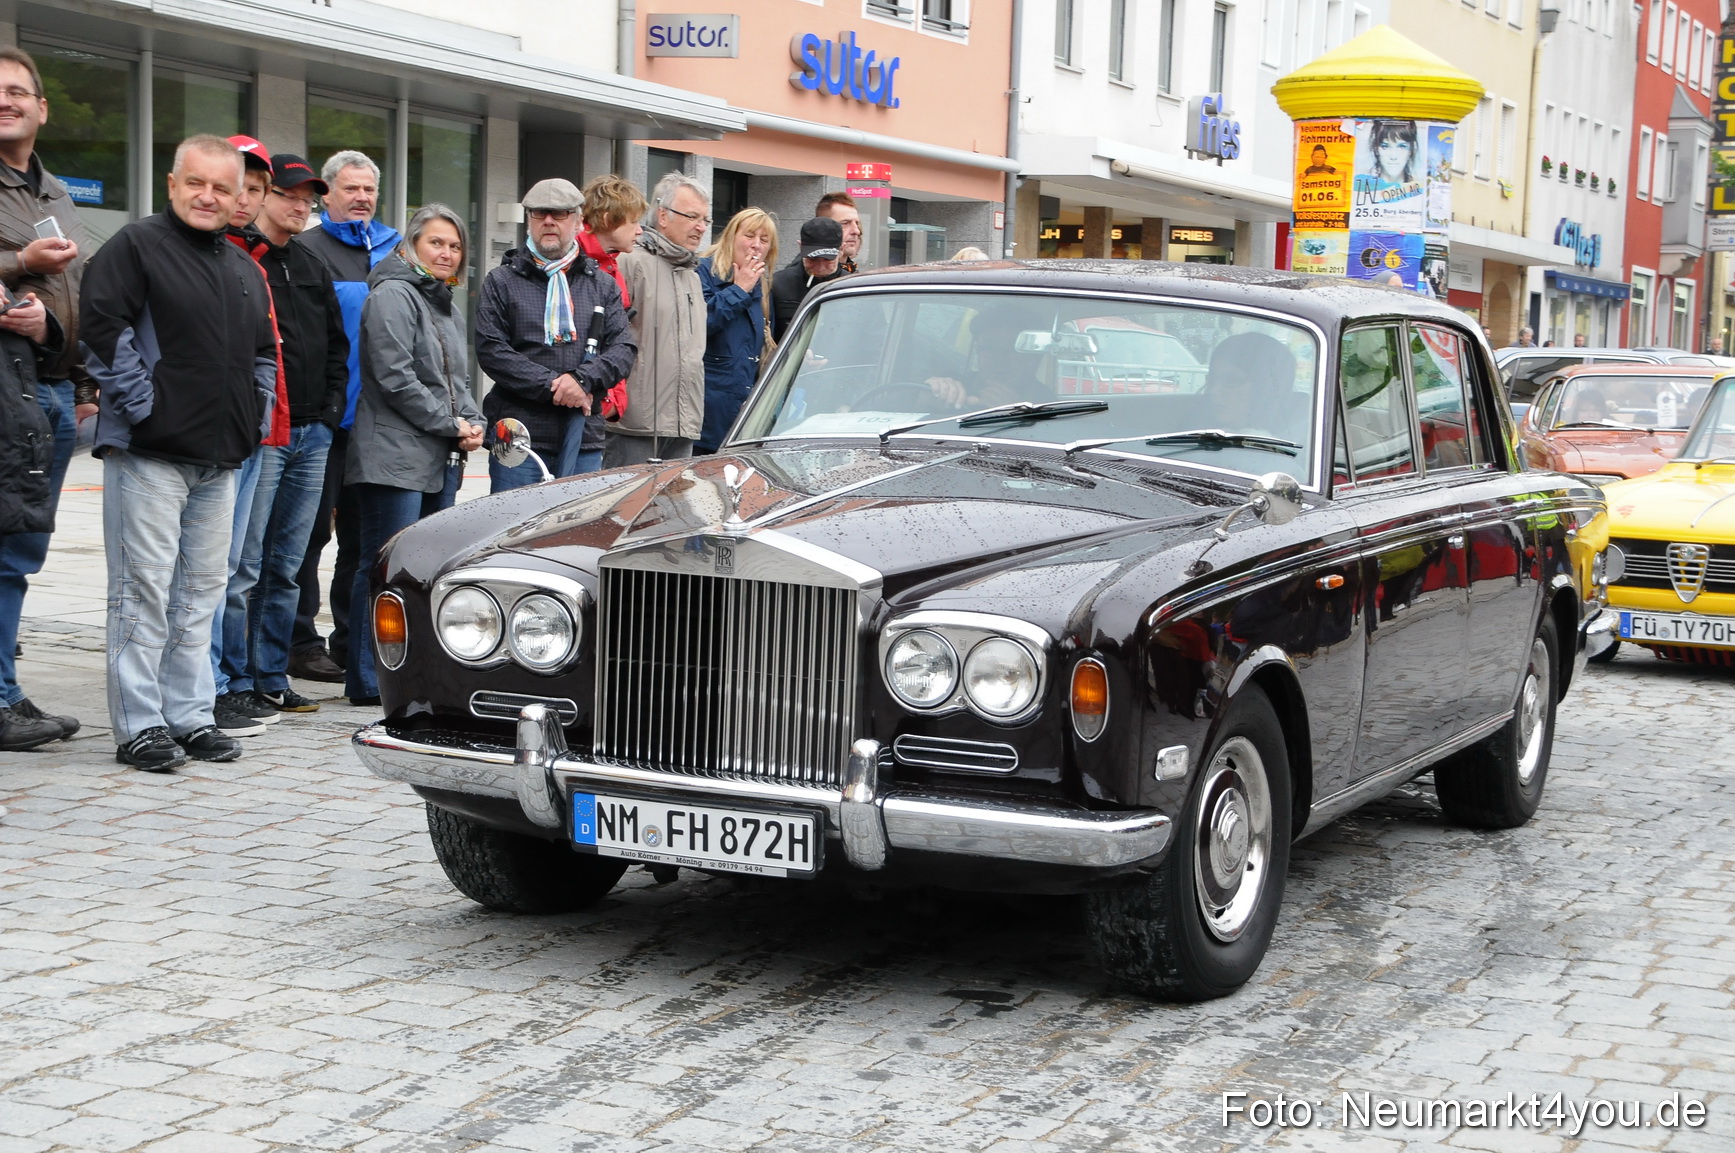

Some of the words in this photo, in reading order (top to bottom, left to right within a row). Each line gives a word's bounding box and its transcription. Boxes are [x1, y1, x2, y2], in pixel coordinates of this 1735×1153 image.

[649, 21, 728, 47] sutor.
[798, 30, 900, 109] sutor.
[1199, 92, 1241, 160] fries
[851, 187, 873, 196] HotSpot
[1301, 180, 1341, 190] Samstag
[1355, 177, 1380, 206] ZAZ
[1382, 187, 1407, 203] OPEN
[1409, 182, 1423, 197] AIR
[1301, 191, 1339, 202] 01.06.
[1354, 207, 1384, 218] 25.6.
[1171, 229, 1214, 242] FRIES
[1316, 266, 1328, 274] Juni
[1329, 266, 1345, 274] 2013
[1632, 616, 1657, 636] FÜ
[581, 823, 591, 835] D
[597, 801, 639, 844] NM
[667, 810, 709, 852] FH
[720, 816, 809, 864] 872H
[620, 850, 636, 858] Auto
[718, 862, 739, 870] 09179
